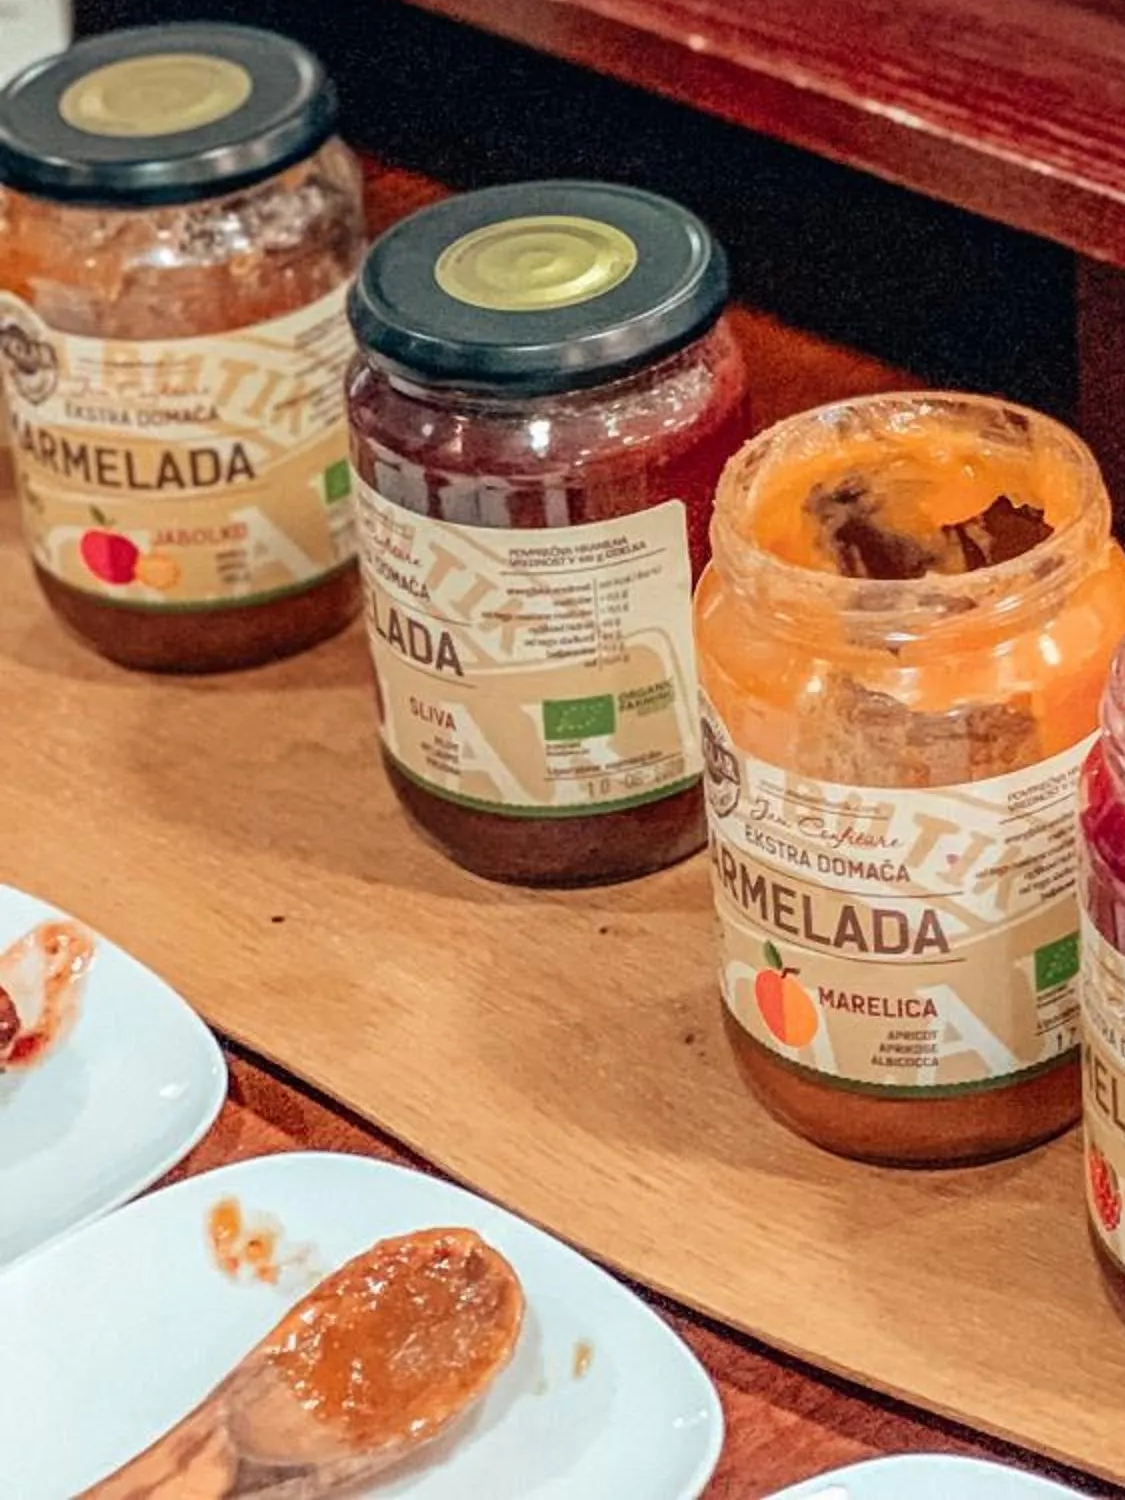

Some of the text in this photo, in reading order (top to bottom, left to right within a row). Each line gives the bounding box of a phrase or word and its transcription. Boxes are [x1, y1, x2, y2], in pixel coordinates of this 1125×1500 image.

[409, 695, 457, 732] SLIVA
[744, 823, 911, 883] EKSTRA DOMAČA
[818, 985, 938, 1019] MARELICA
